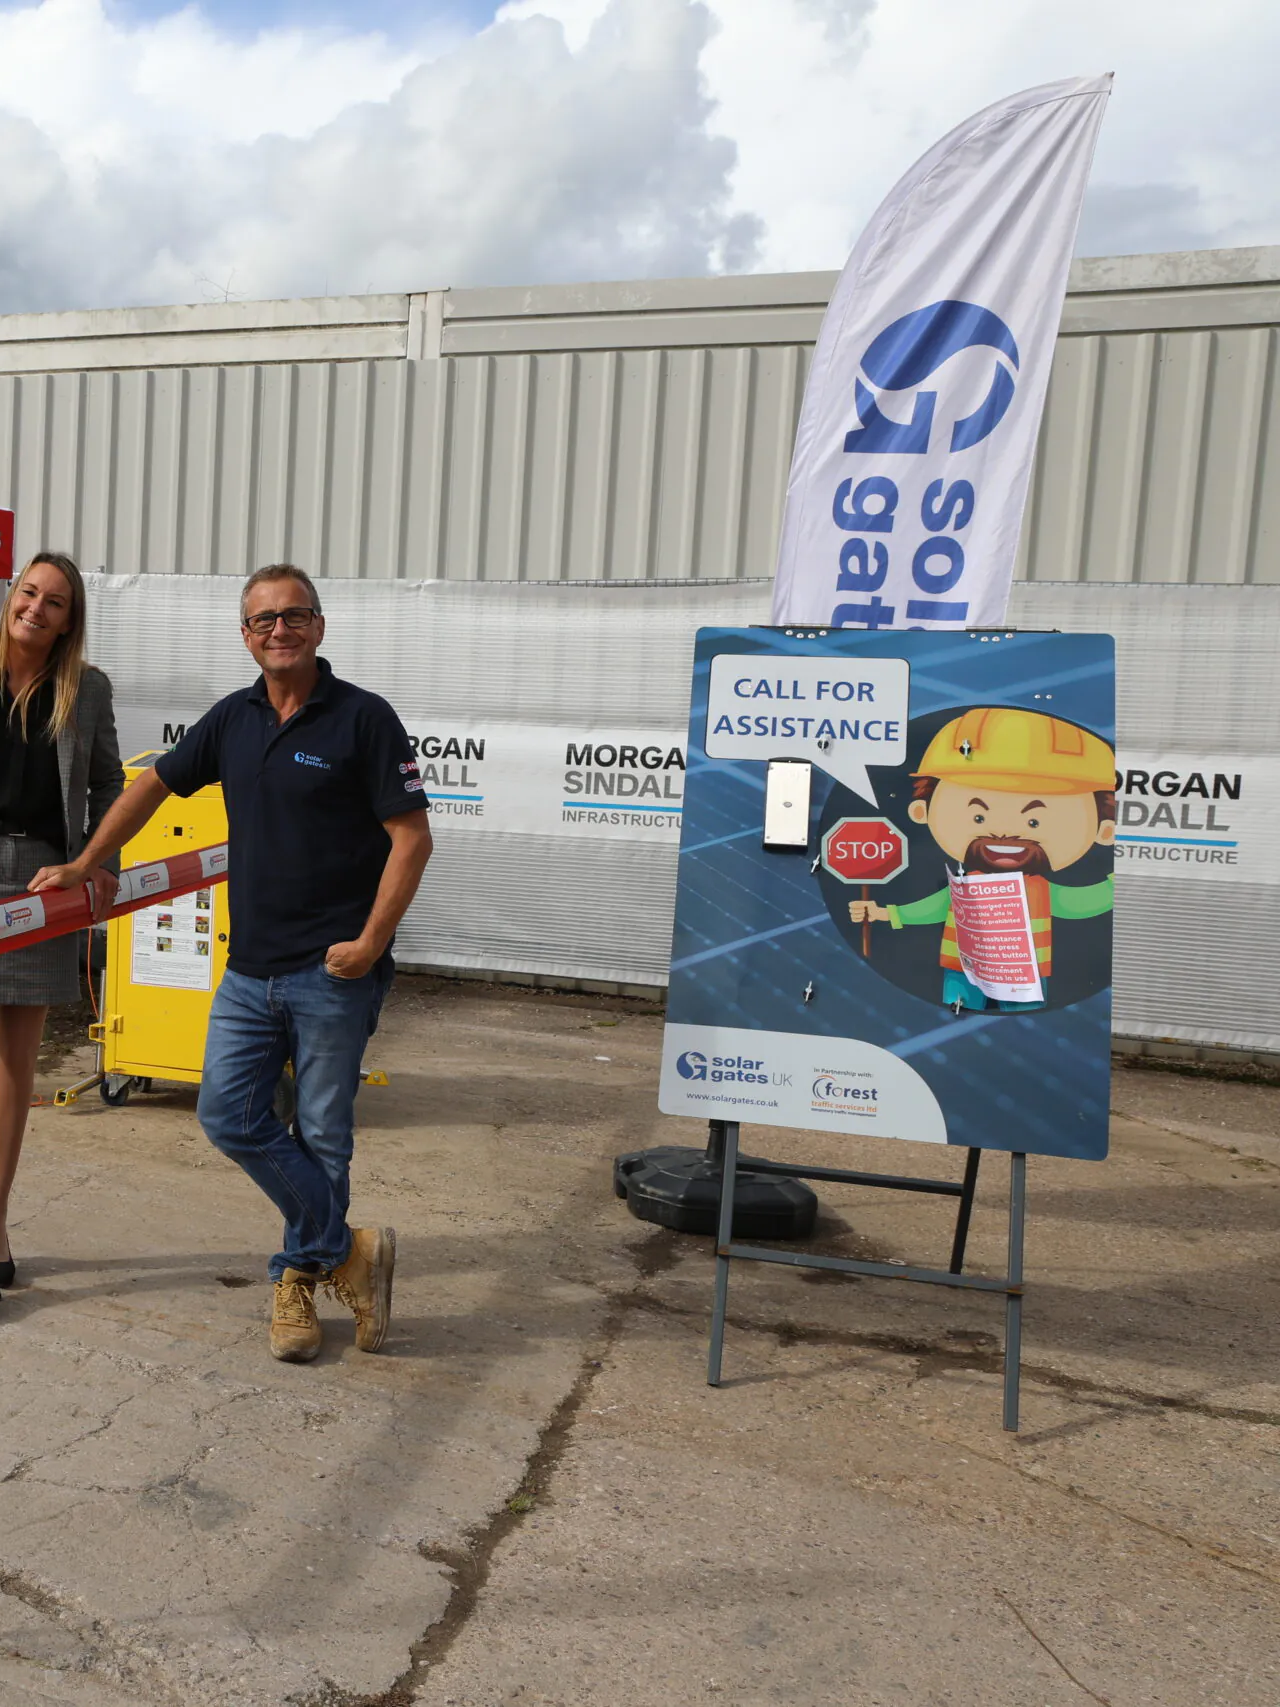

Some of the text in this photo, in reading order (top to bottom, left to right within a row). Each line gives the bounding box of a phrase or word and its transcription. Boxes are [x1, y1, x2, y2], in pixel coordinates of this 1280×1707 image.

[830, 476, 899, 630] gat
[906, 478, 975, 631] sol
[733, 678, 875, 702] CALL FOR
[713, 715, 900, 742] ASSISTANCE
[407, 735, 486, 761] RGAN
[565, 743, 686, 771] MORGA
[562, 771, 683, 800] SINDAL
[1115, 769, 1242, 800] RGAN
[1114, 800, 1231, 831] DALL
[835, 841, 894, 860] STOP
[1114, 844, 1239, 865] STRUCTURE
[968, 883, 1016, 895] Closed
[711, 1055, 764, 1071] solar
[821, 1068, 857, 1077] Partnership
[710, 1068, 793, 1087] gates UK
[686, 1091, 779, 1108] www.solargates.co.uk
[825, 1082, 878, 1101] forest
